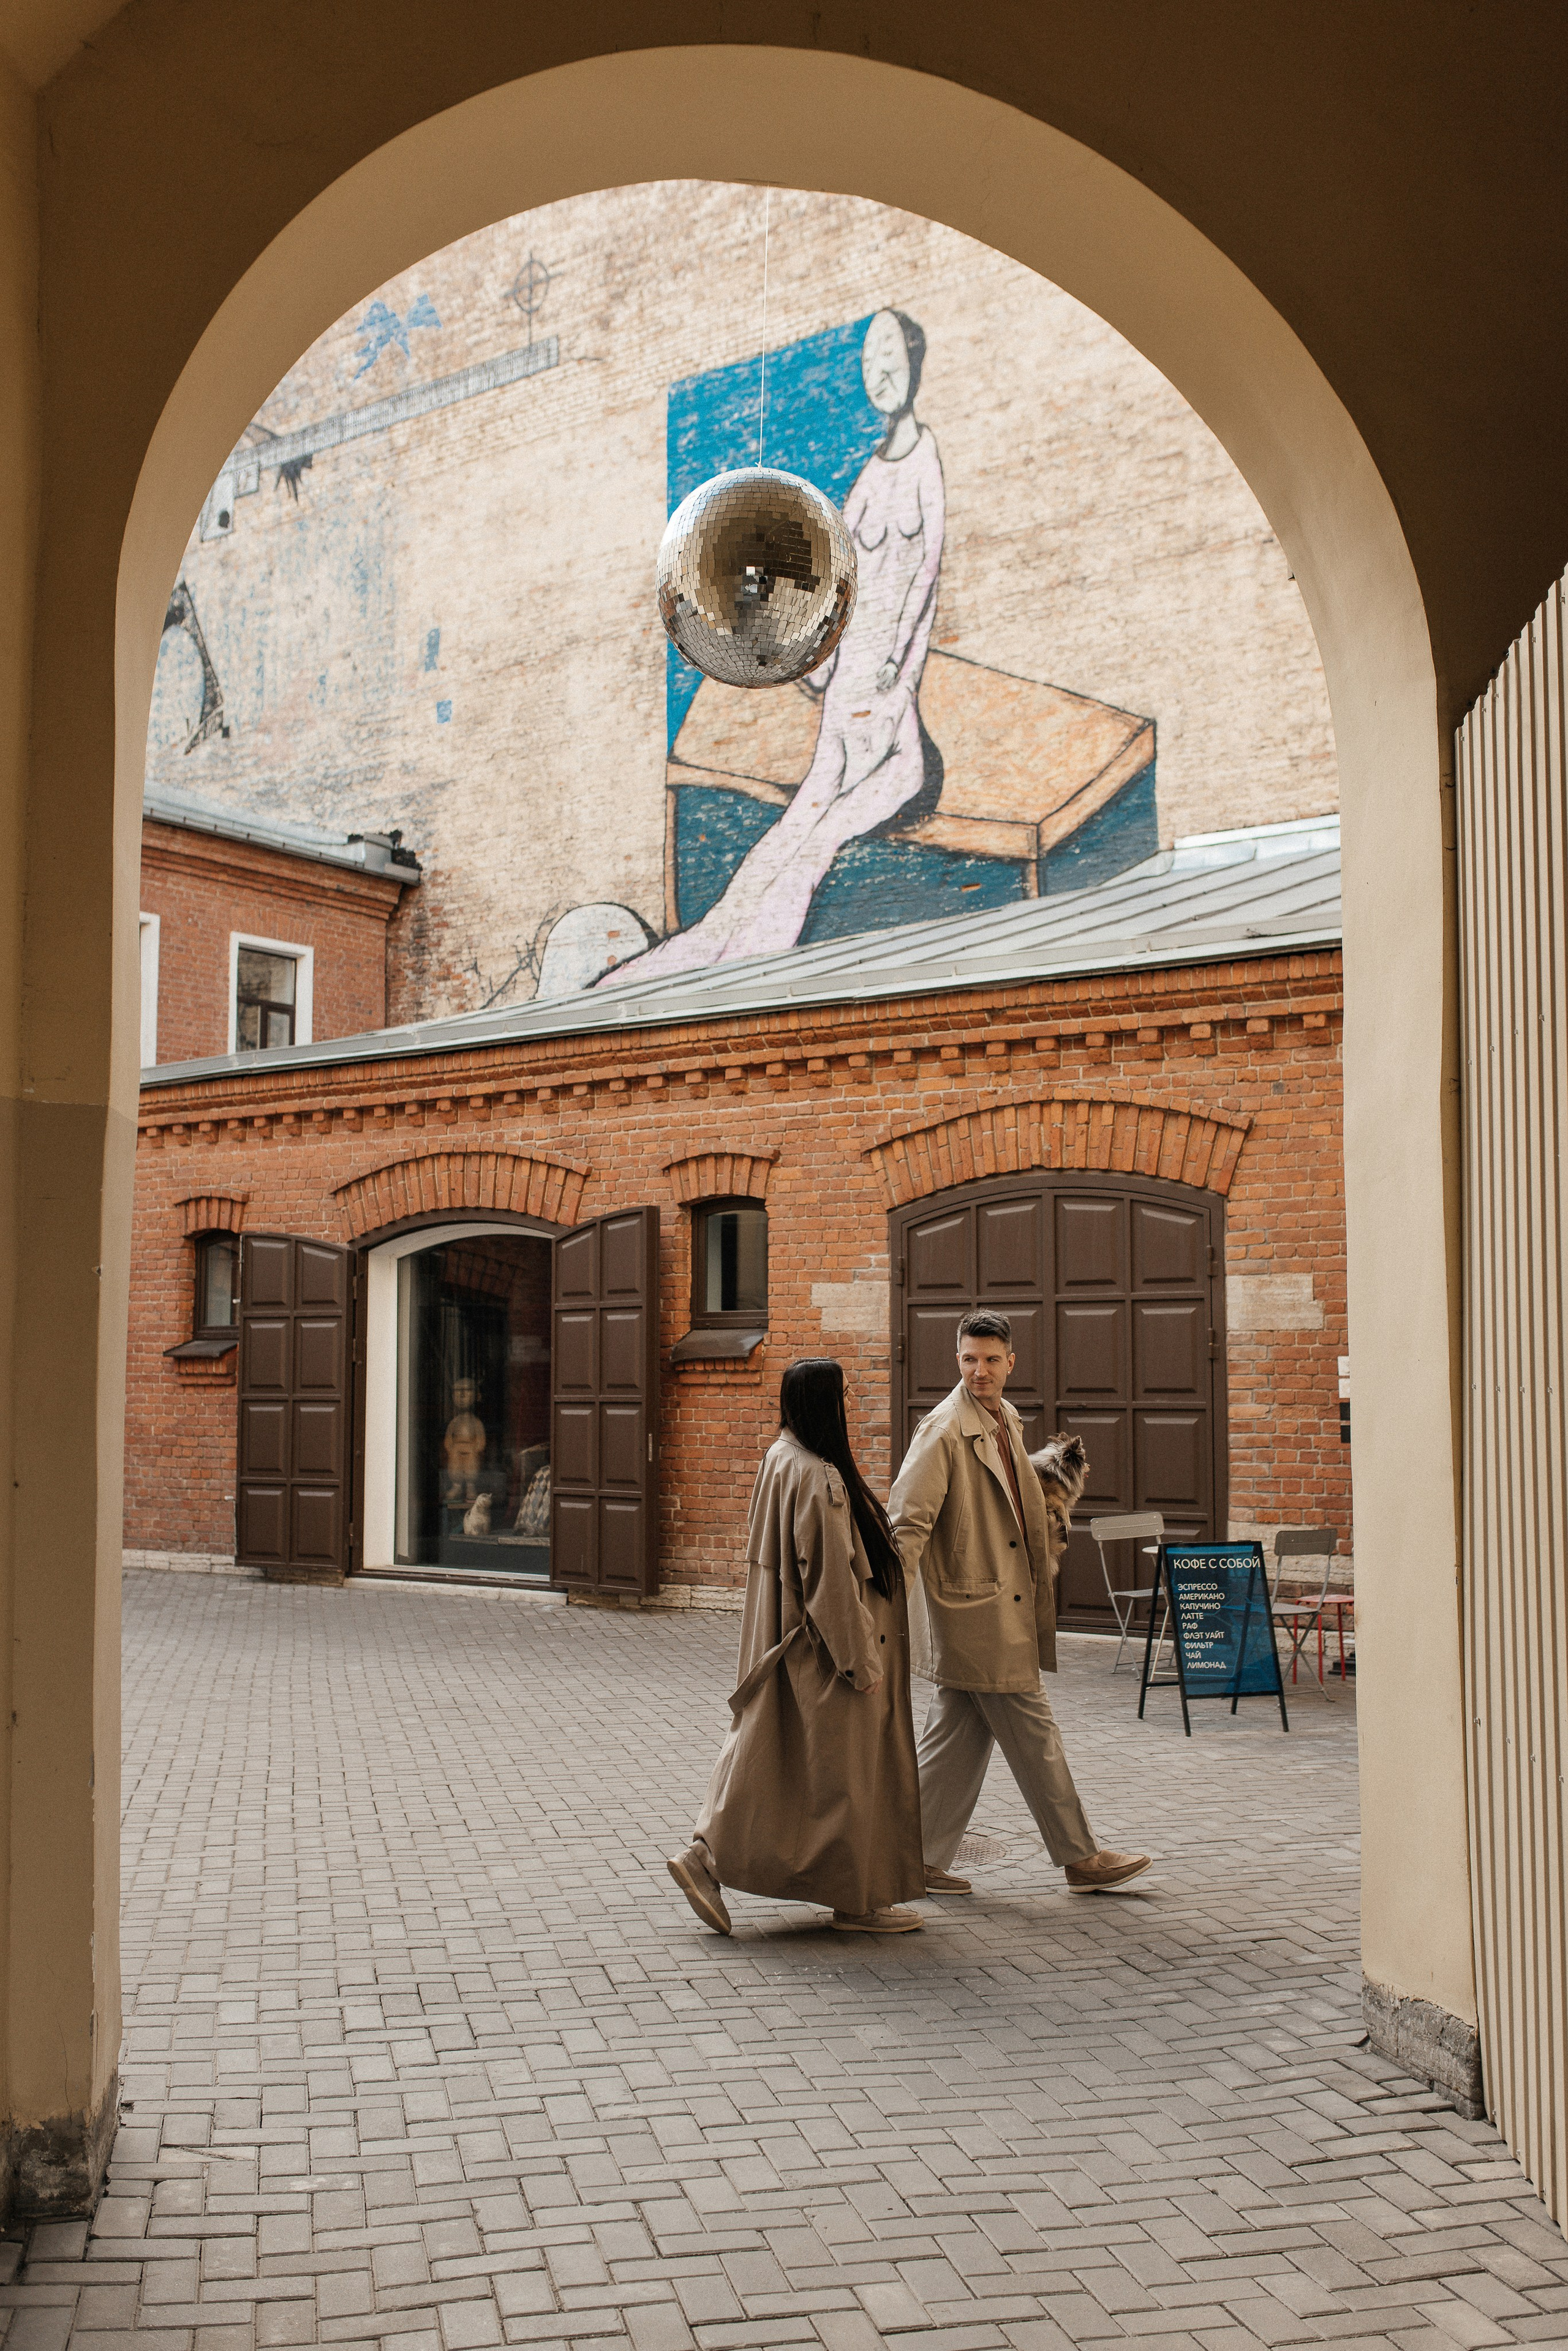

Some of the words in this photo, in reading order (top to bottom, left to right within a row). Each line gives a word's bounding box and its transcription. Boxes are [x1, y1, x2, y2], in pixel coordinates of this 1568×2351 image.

[1174, 1558, 1207, 1569] КОФЕ
[1208, 1558, 1216, 1569] С
[1219, 1556, 1261, 1569] СОБОЙ
[1205, 1631, 1224, 1639] УАЙТ
[1186, 1650, 1201, 1659] ЧАЙ
